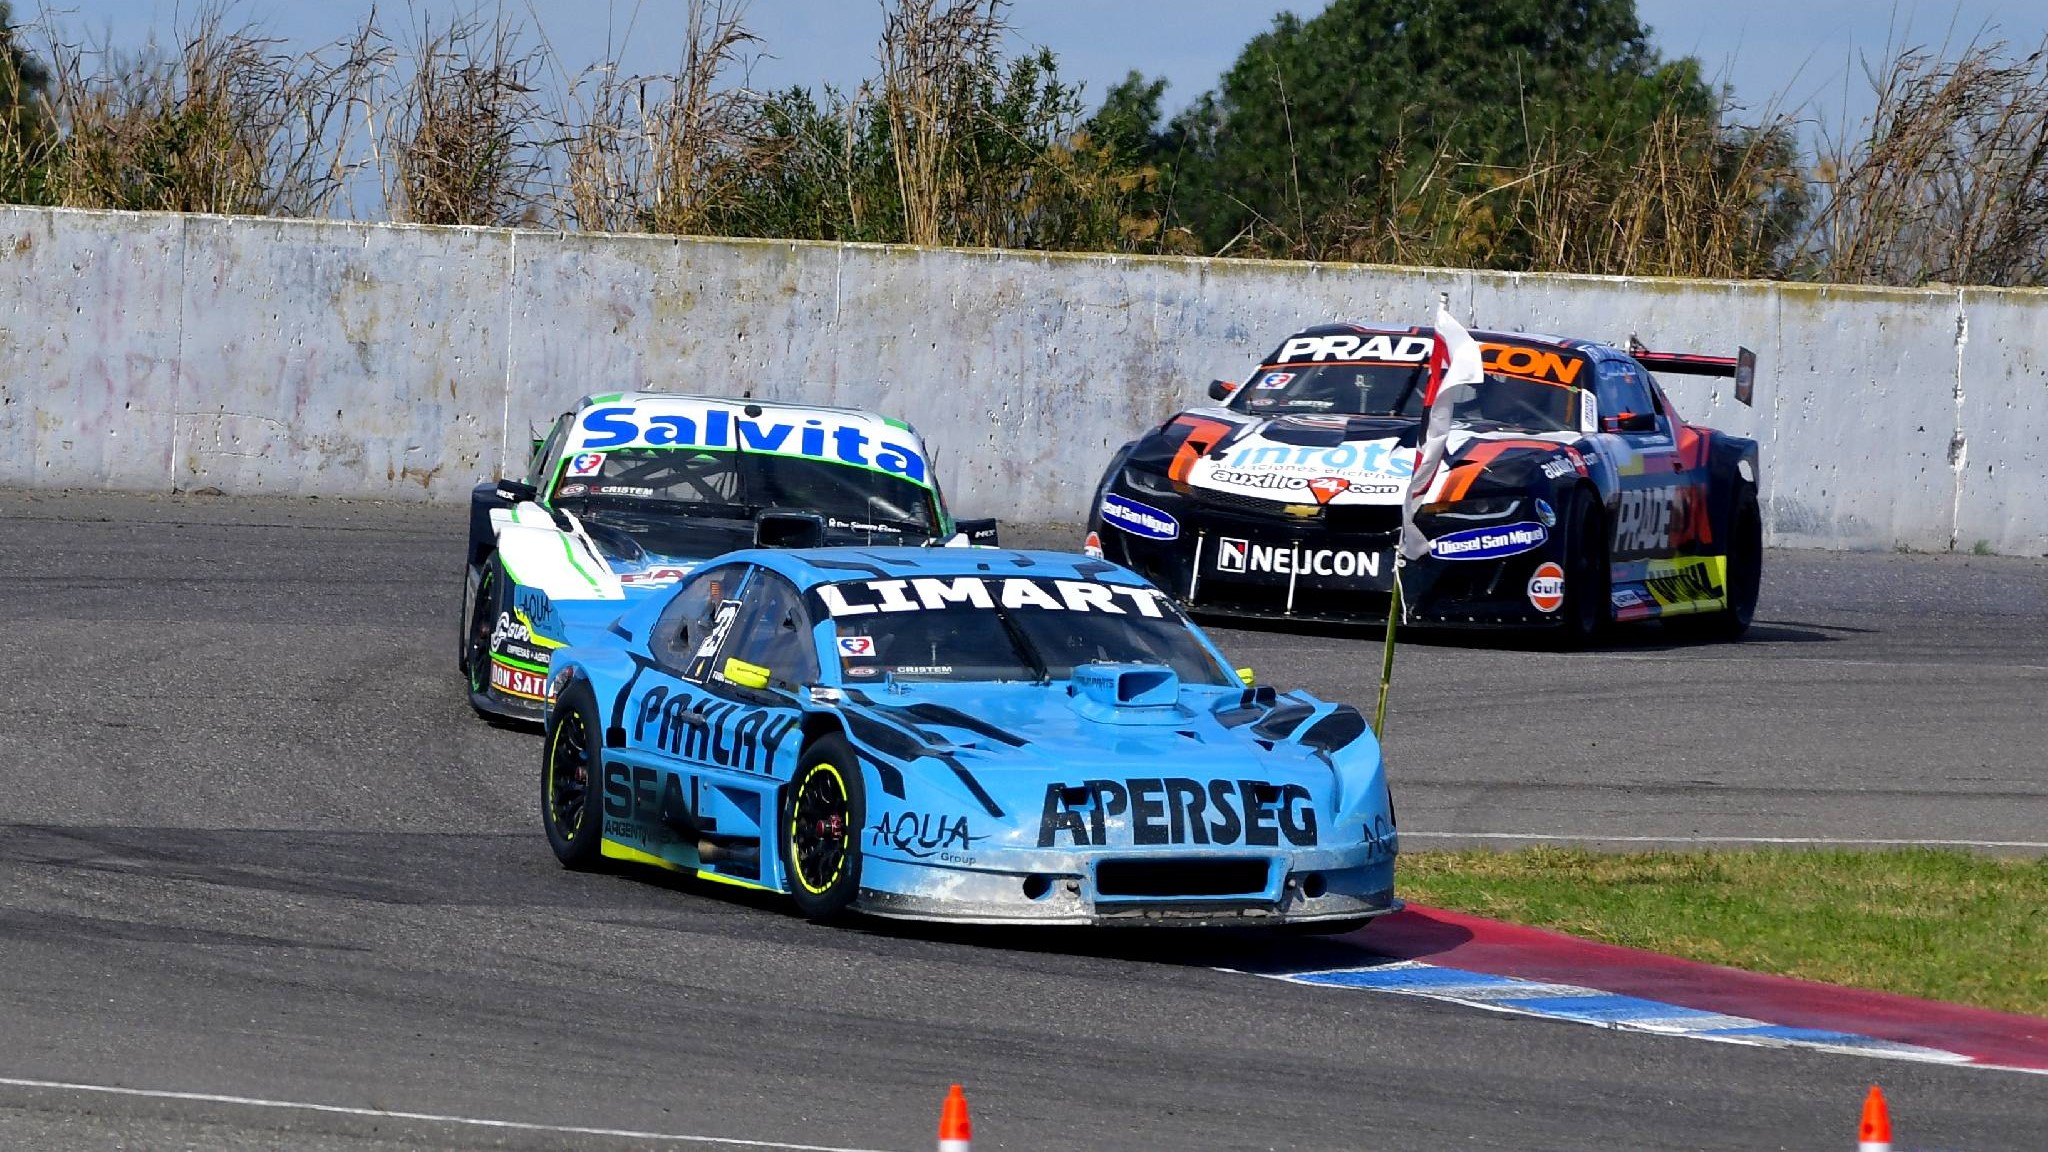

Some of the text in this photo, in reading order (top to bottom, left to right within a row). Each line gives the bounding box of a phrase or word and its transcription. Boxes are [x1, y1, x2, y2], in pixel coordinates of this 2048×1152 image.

[582, 407, 925, 483] Salvita
[601, 486, 654, 496] CRISTEM
[1438, 526, 1544, 555] Diesel San Miguel
[1250, 544, 1380, 577] NEUCON
[817, 577, 1164, 618] LIMART
[492, 663, 511, 689] DON
[897, 666, 953, 674] CRISTEM
[604, 760, 718, 832] SEAL
[1036, 777, 1318, 848] APERSEG
[870, 811, 992, 858] AQUA
[940, 852, 977, 867] Group
